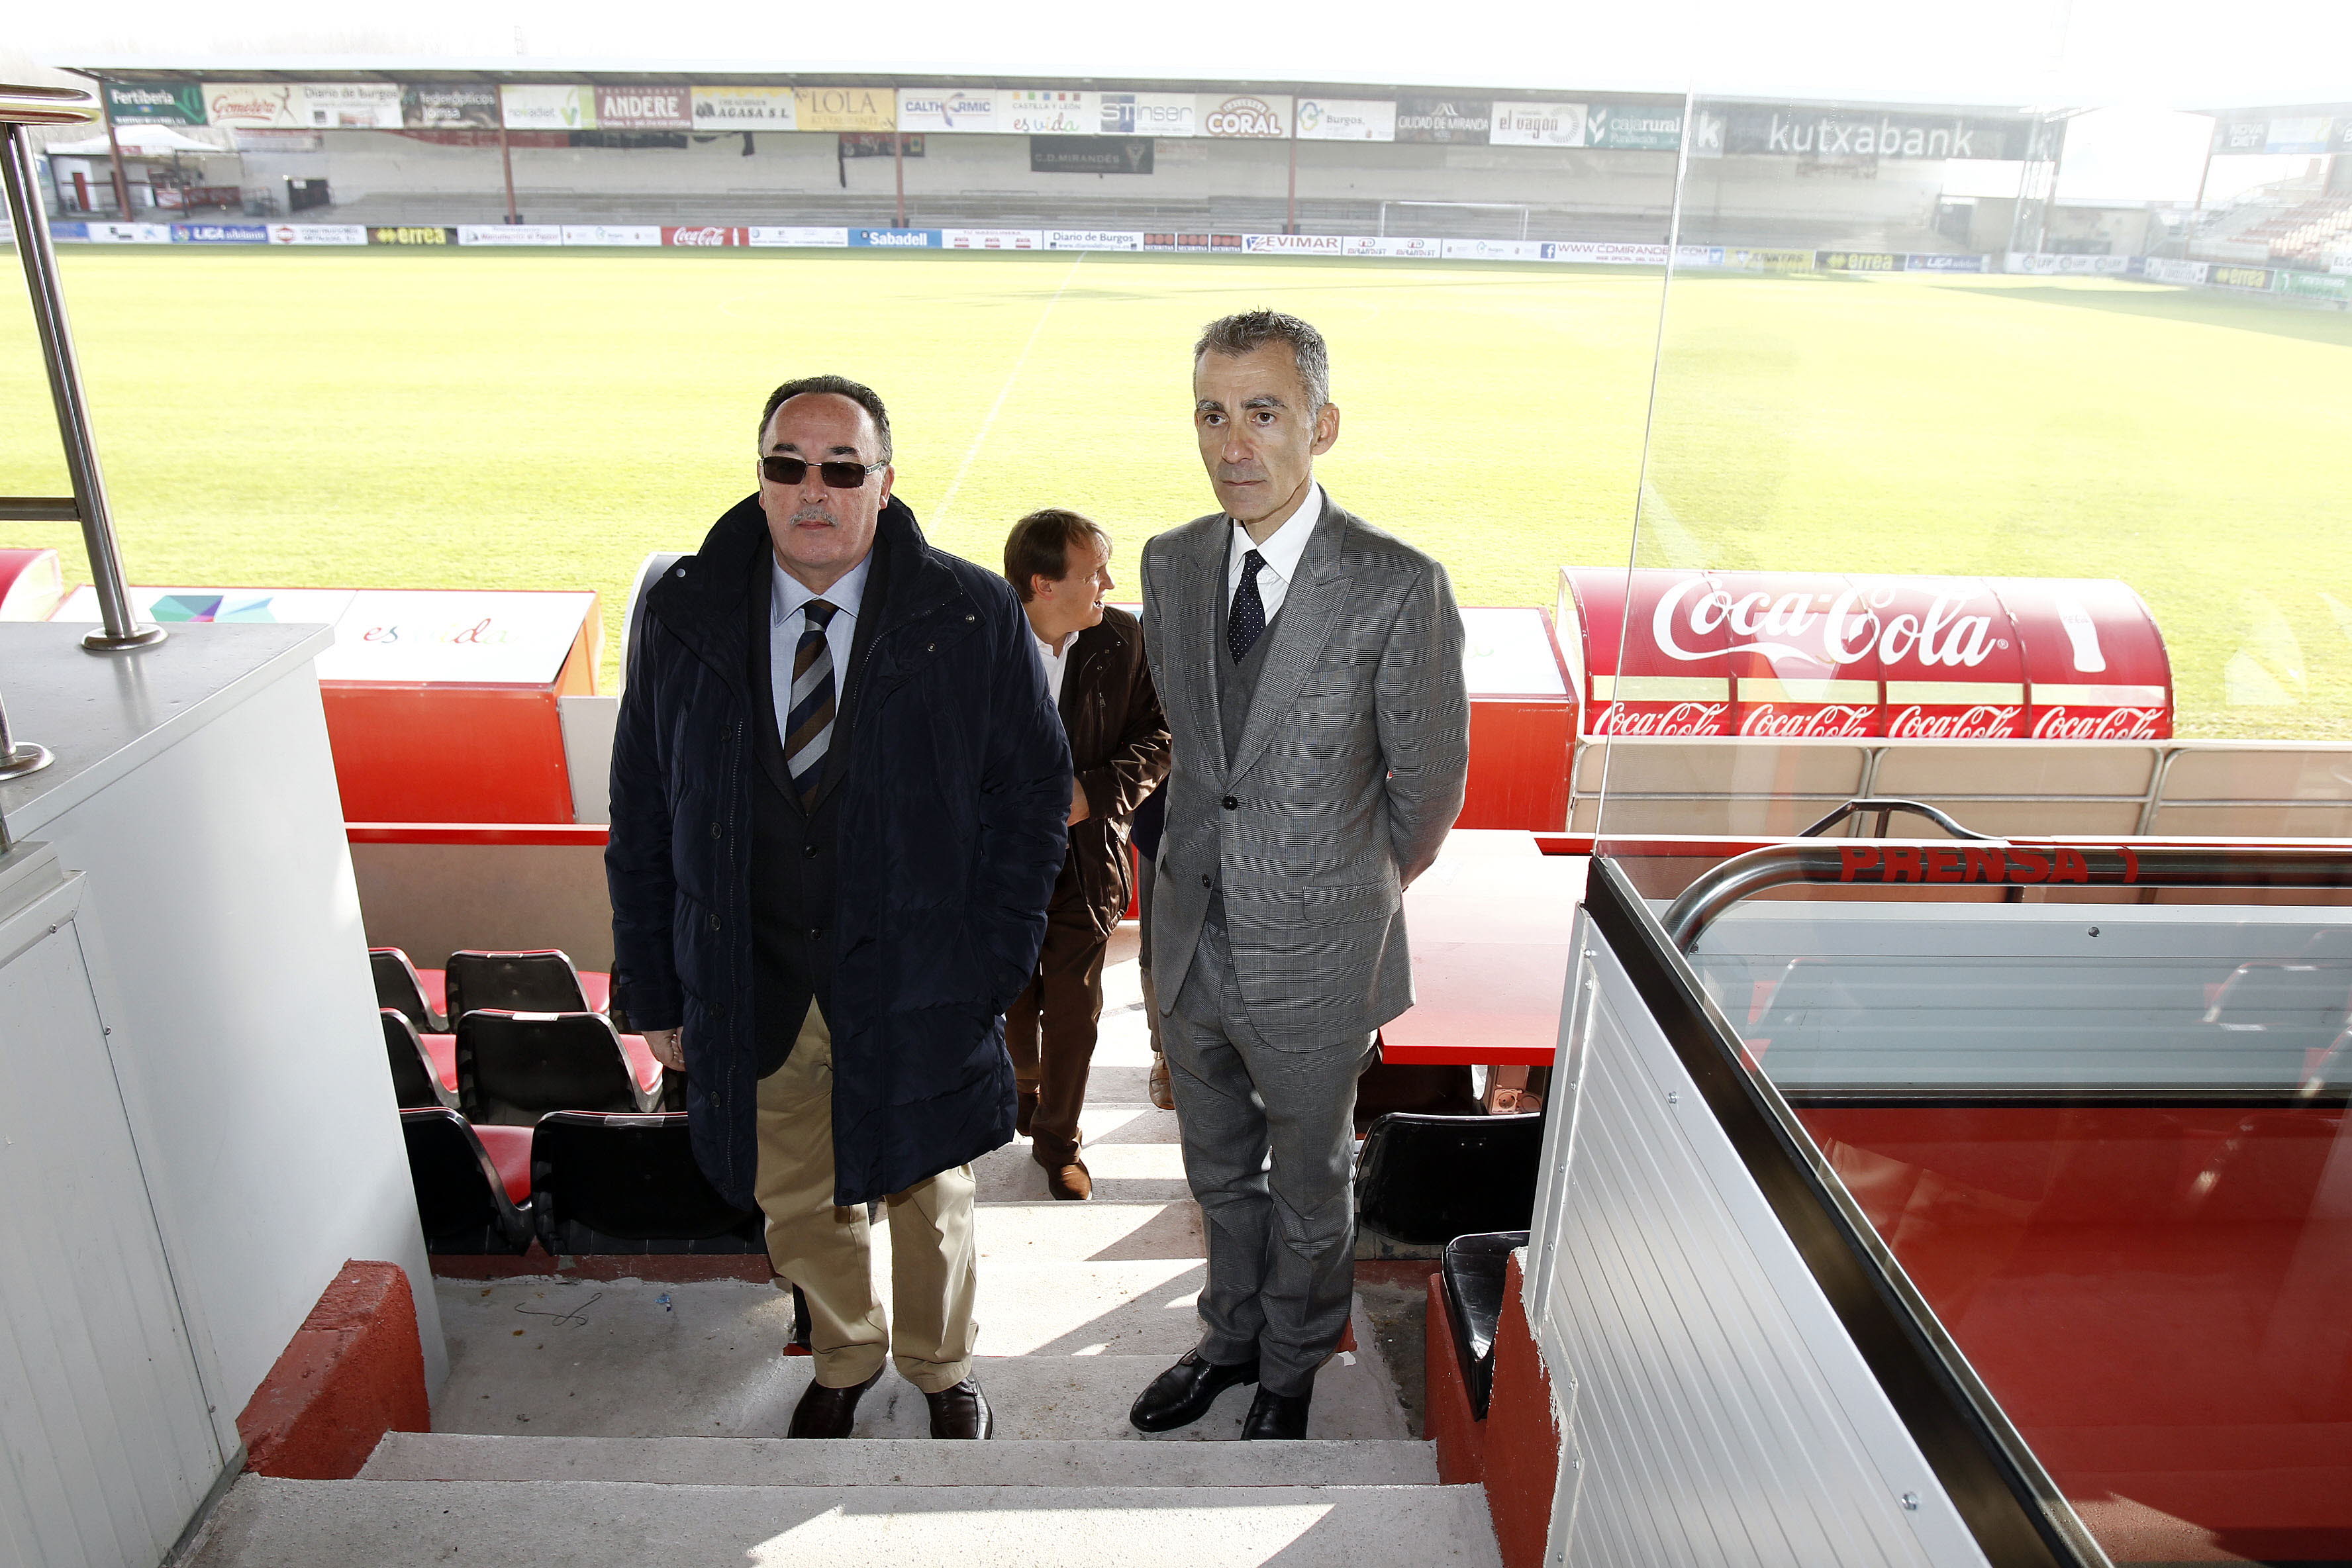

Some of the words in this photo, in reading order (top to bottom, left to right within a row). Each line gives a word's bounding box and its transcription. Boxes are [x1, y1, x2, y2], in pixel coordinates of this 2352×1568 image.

[111, 89, 175, 105] Fertiberia
[305, 85, 338, 99] Diario
[341, 86, 354, 98] de
[603, 95, 679, 117] ANDERE
[810, 89, 877, 115] LOLA
[718, 106, 763, 118] AGASA
[1013, 117, 1030, 132] es
[1033, 111, 1081, 132] vida
[1499, 109, 1512, 130] el
[1206, 113, 1281, 134] CORAL
[1398, 115, 1432, 130] CIUDAD
[1434, 117, 1447, 130] DE
[1447, 117, 1489, 132] MIRANDA
[1610, 115, 1681, 134] cajarural
[1769, 113, 1975, 157] kutxabank
[192, 226, 225, 240] LIGA
[397, 226, 446, 244] errea
[869, 232, 928, 246] Sabadell
[1053, 231, 1081, 242] Diario
[1085, 231, 1097, 242] de
[1099, 232, 1134, 244] Burgos
[1266, 236, 1338, 248] EVIMAR
[1848, 253, 1893, 271] errea
[2229, 268, 2266, 287] errea
[1653, 576, 1996, 667] Coca-Cola
[364, 625, 399, 644] es
[1592, 701, 1729, 736] Coca-Cola
[1740, 703, 1876, 737] Coca-Cola
[1888, 705, 2022, 739] Coca-Cola
[2032, 705, 2165, 740] Coca-Cola
[1836, 845, 2089, 883] PRENSA
